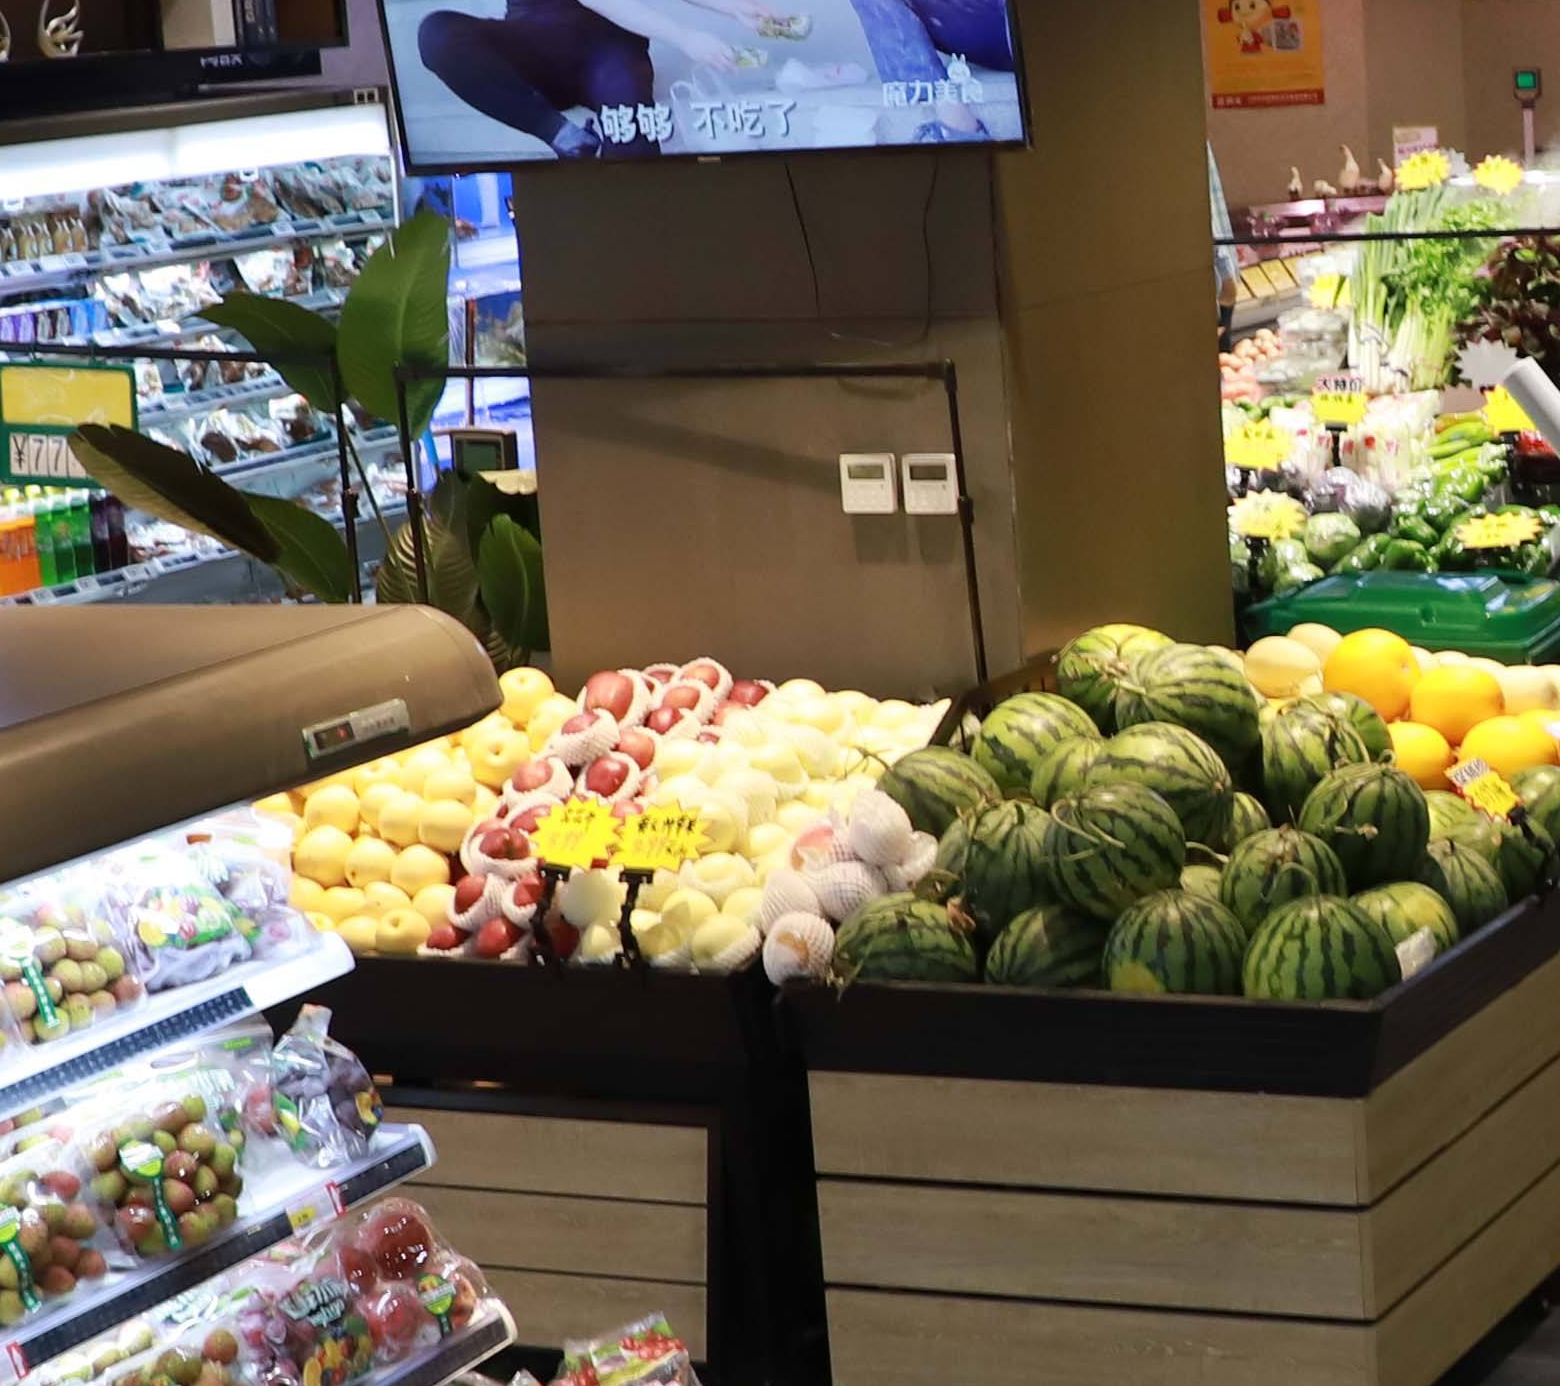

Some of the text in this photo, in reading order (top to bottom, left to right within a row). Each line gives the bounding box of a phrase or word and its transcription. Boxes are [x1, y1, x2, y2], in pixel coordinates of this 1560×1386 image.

[882, 79, 984, 106] 魔力美食
[600, 100, 797, 142] 够够 不吃了
